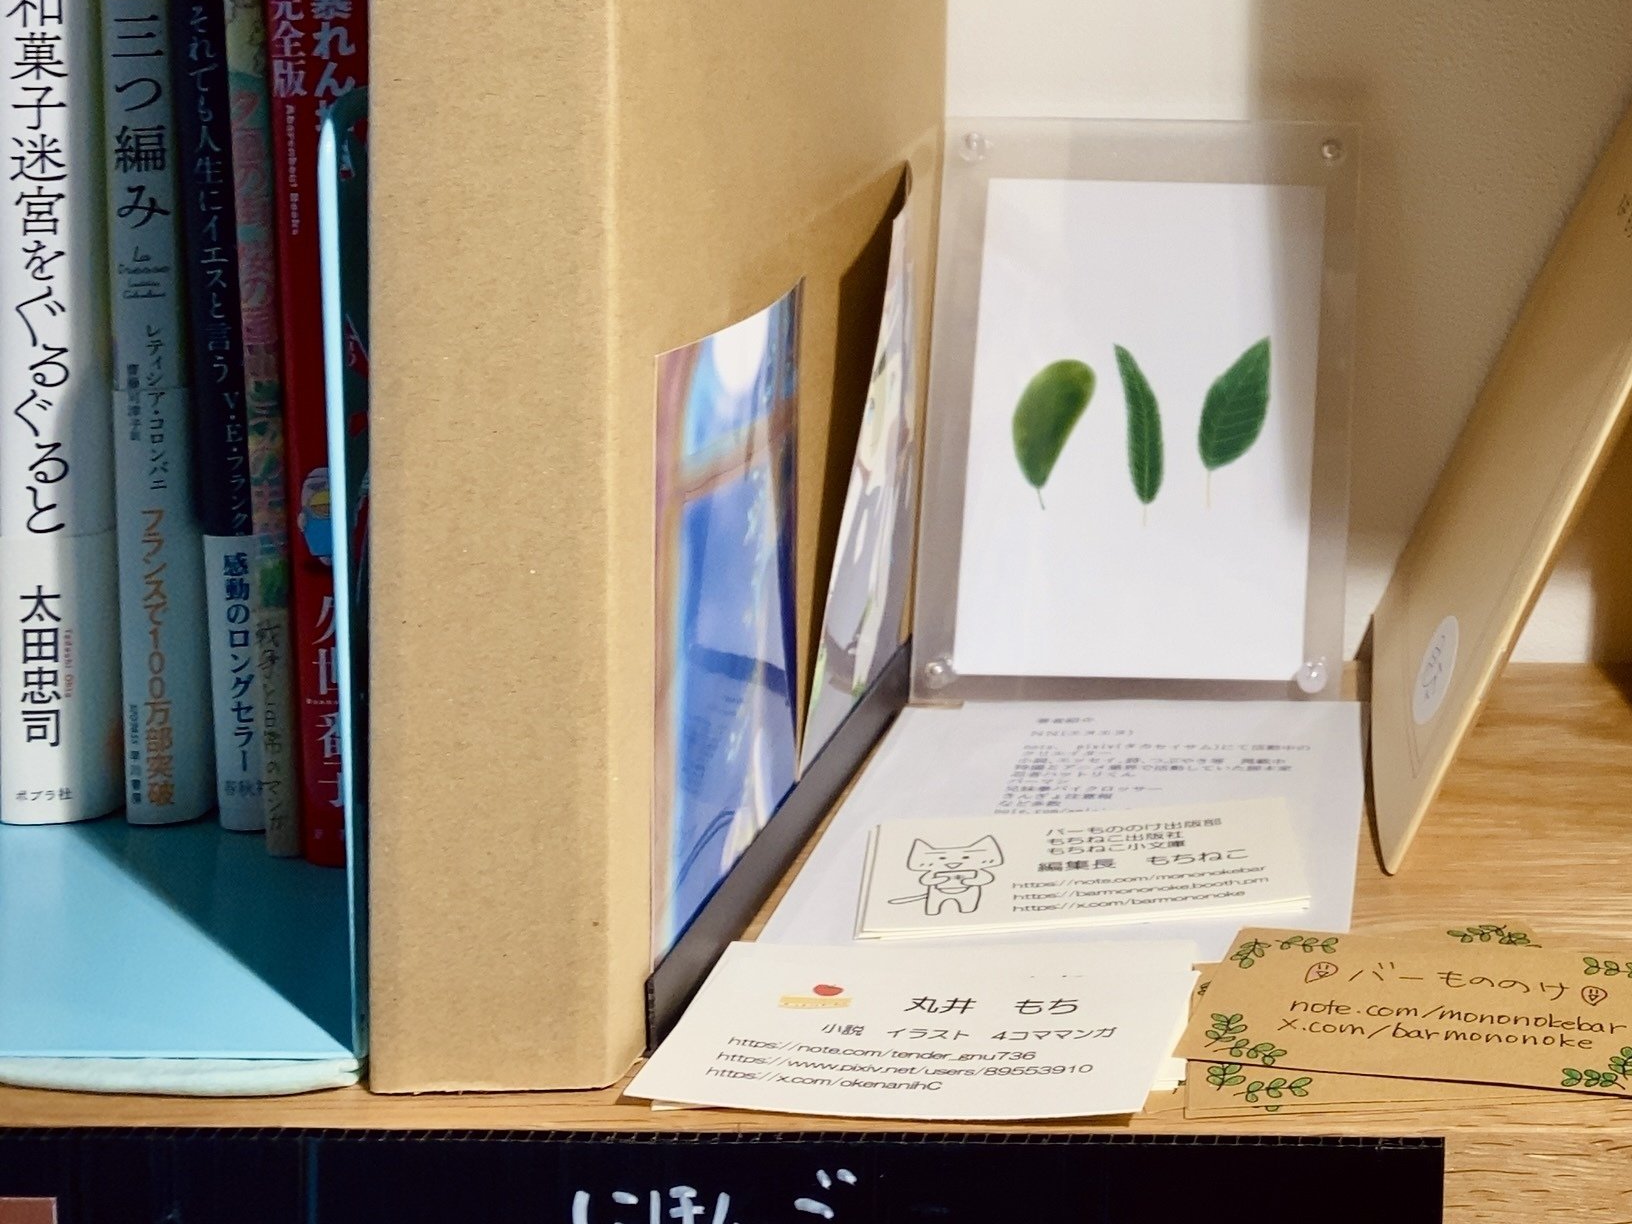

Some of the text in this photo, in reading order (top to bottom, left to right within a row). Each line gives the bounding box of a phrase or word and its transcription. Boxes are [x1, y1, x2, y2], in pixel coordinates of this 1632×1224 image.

[111, 14, 171, 228] 三つ編み
[19, 585, 63, 748] 太田忠司
[222, 552, 256, 773] 感動のロングセラー
[1037, 848, 1249, 873] 編集長 もちねこ
[1347, 962, 1570, 1001] バーもののけ
[904, 996, 1078, 1015] 丸井 もち
[1290, 999, 1627, 1035] note.com/mononokebar
[821, 1023, 1117, 1041] 小説 イラスト 4コママンガ
[1277, 1018, 1594, 1051] x.com/barmononoke
